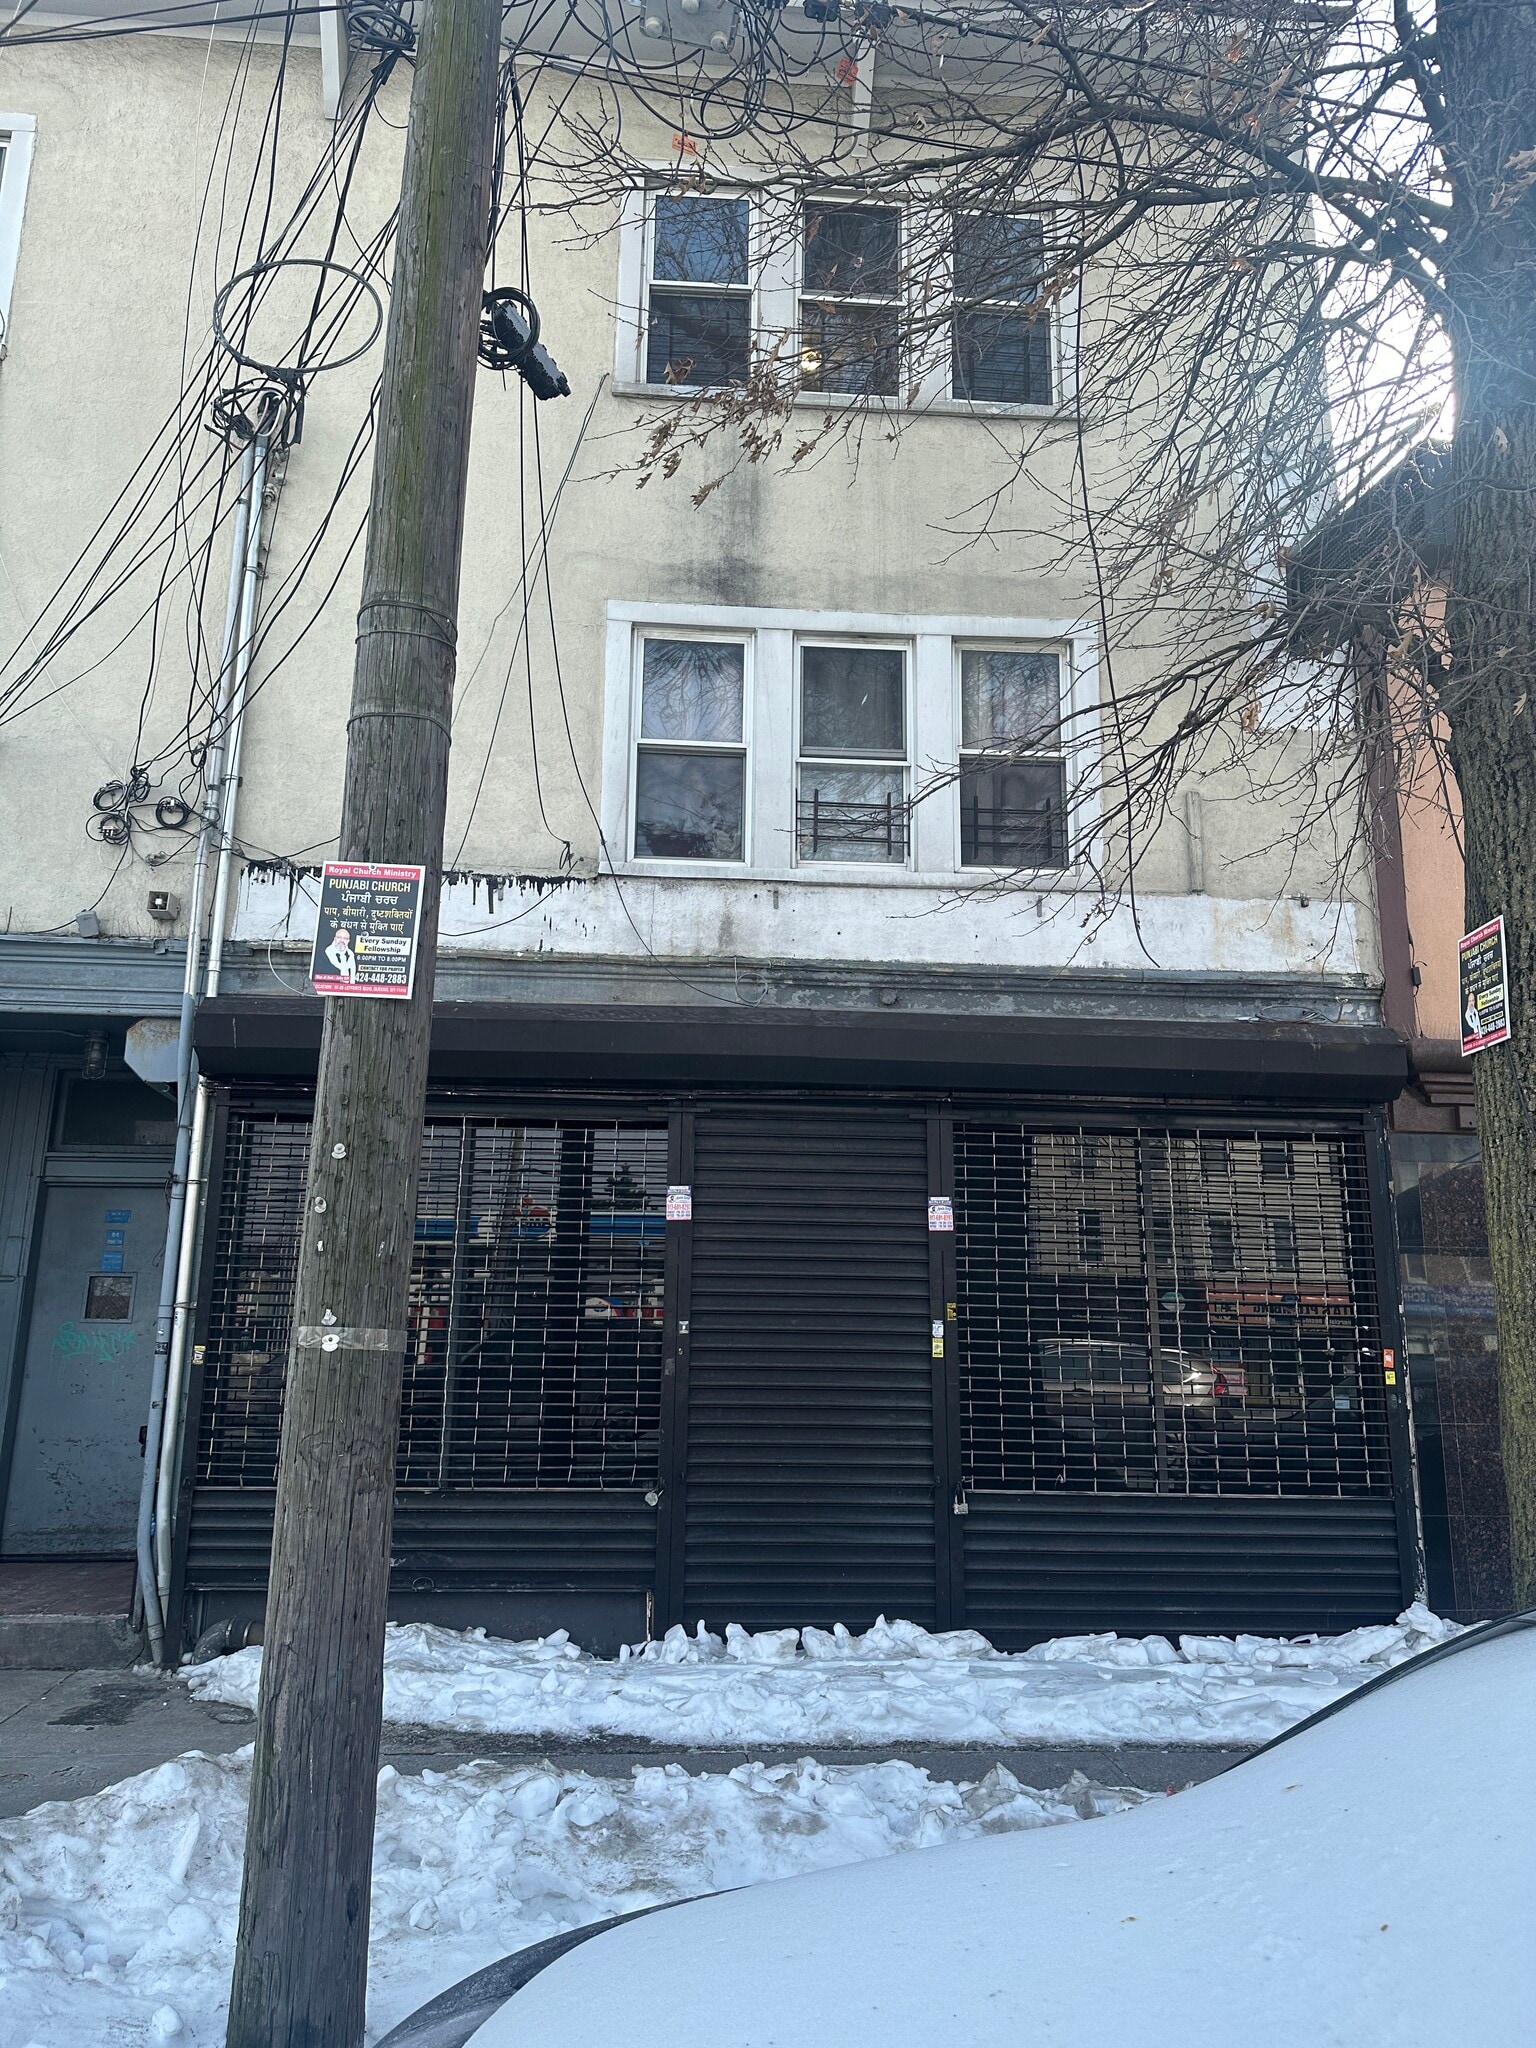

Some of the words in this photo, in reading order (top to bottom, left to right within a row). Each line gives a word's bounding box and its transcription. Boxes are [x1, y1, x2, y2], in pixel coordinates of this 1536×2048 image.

[329, 866, 351, 875] Royal
[353, 868, 381, 876] Church
[384, 870, 416, 878] Ministry
[329, 879, 369, 890] PUNJABI
[372, 881, 411, 892] CHURCH
[342, 890, 372, 904] ਪੰਜਾਬੀ
[375, 895, 398, 905] ਚਰਚ
[324, 907, 340, 917] पाप,
[330, 918, 338, 928] के
[360, 920, 368, 930] से
[369, 920, 388, 933] मुक्ति
[360, 937, 380, 945] Every
[382, 938, 406, 946] Sunday
[1480, 935, 1498, 951] CHURCH
[364, 945, 401, 953] Fellowship
[355, 972, 407, 984] 424-448-2883
